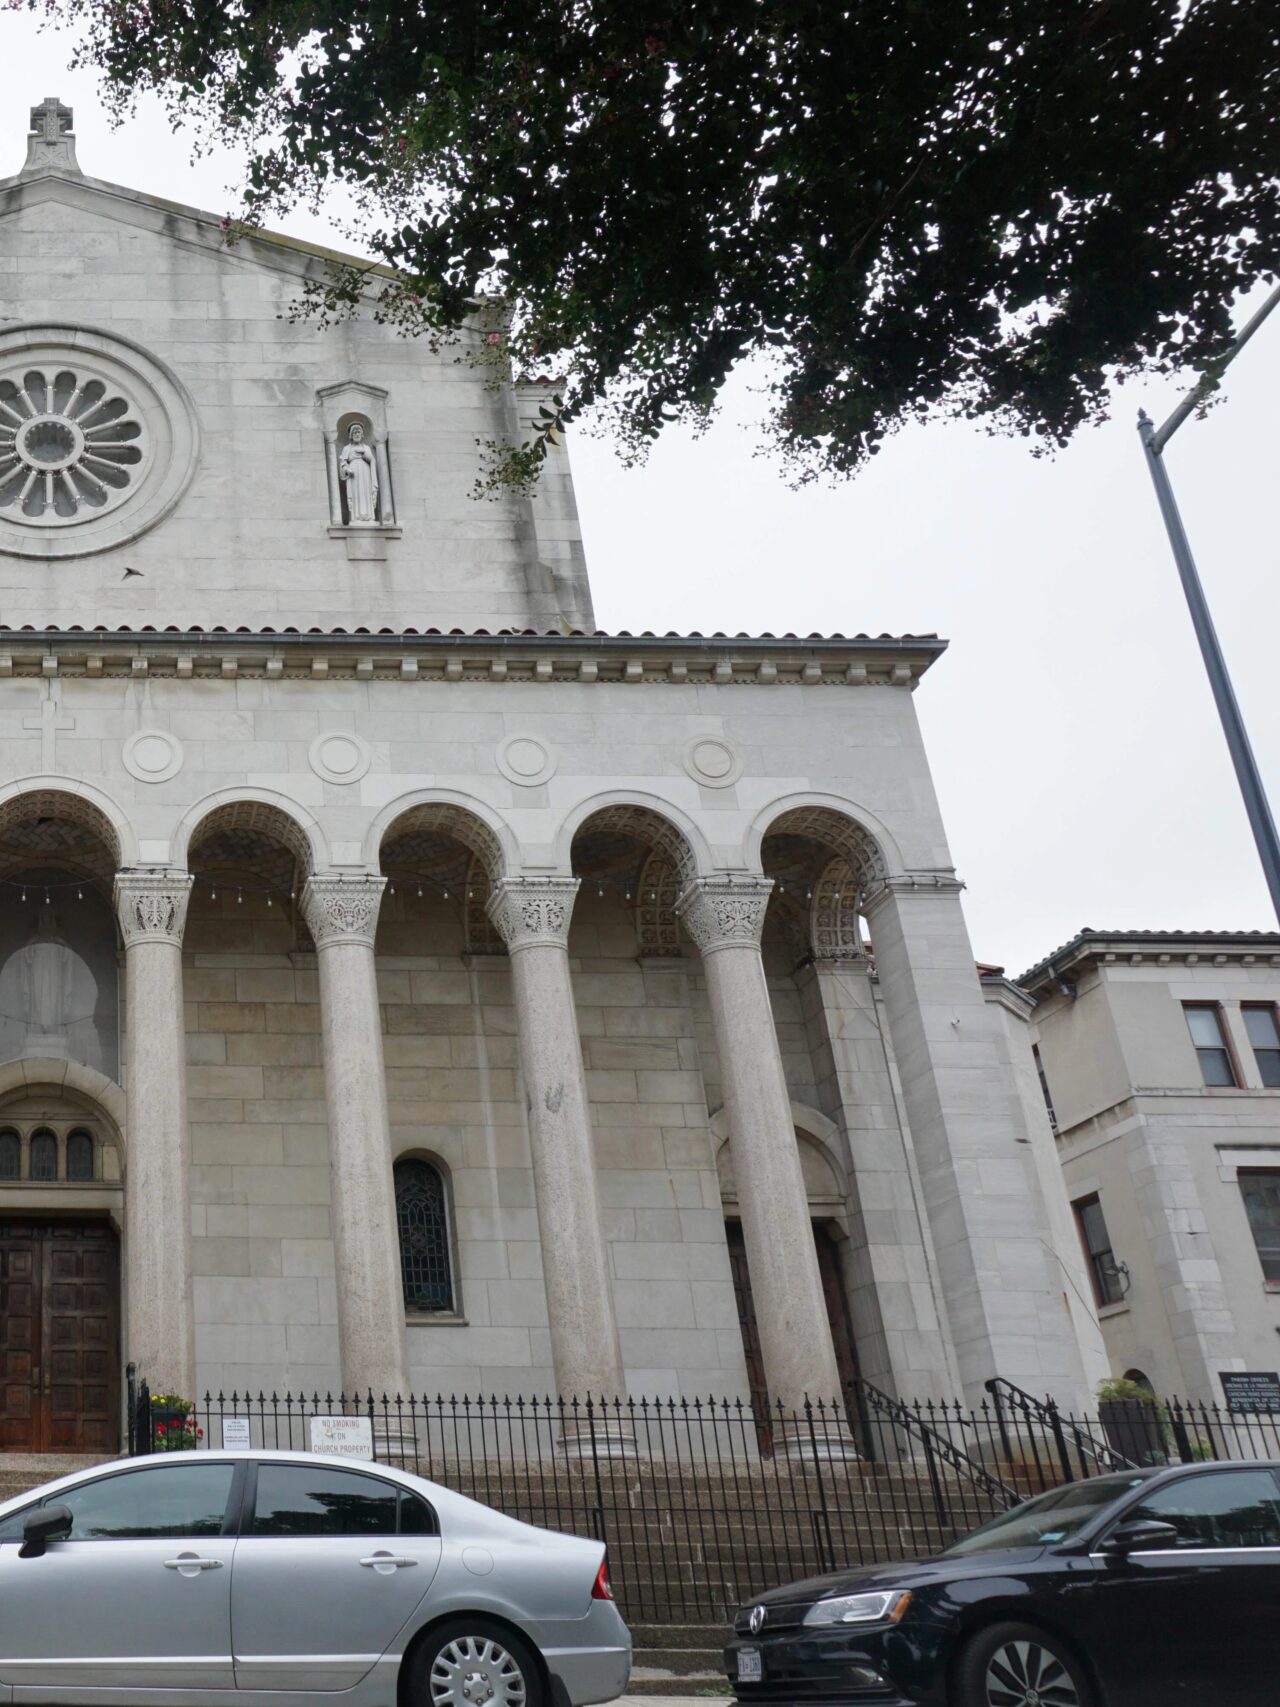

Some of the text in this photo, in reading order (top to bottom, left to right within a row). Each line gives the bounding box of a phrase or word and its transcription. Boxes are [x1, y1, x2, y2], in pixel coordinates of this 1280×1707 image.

[322, 1419, 360, 1428] NO SMOKING
[337, 1432, 346, 1440] ON
[314, 1444, 370, 1454] CHURCH PROPERTY
